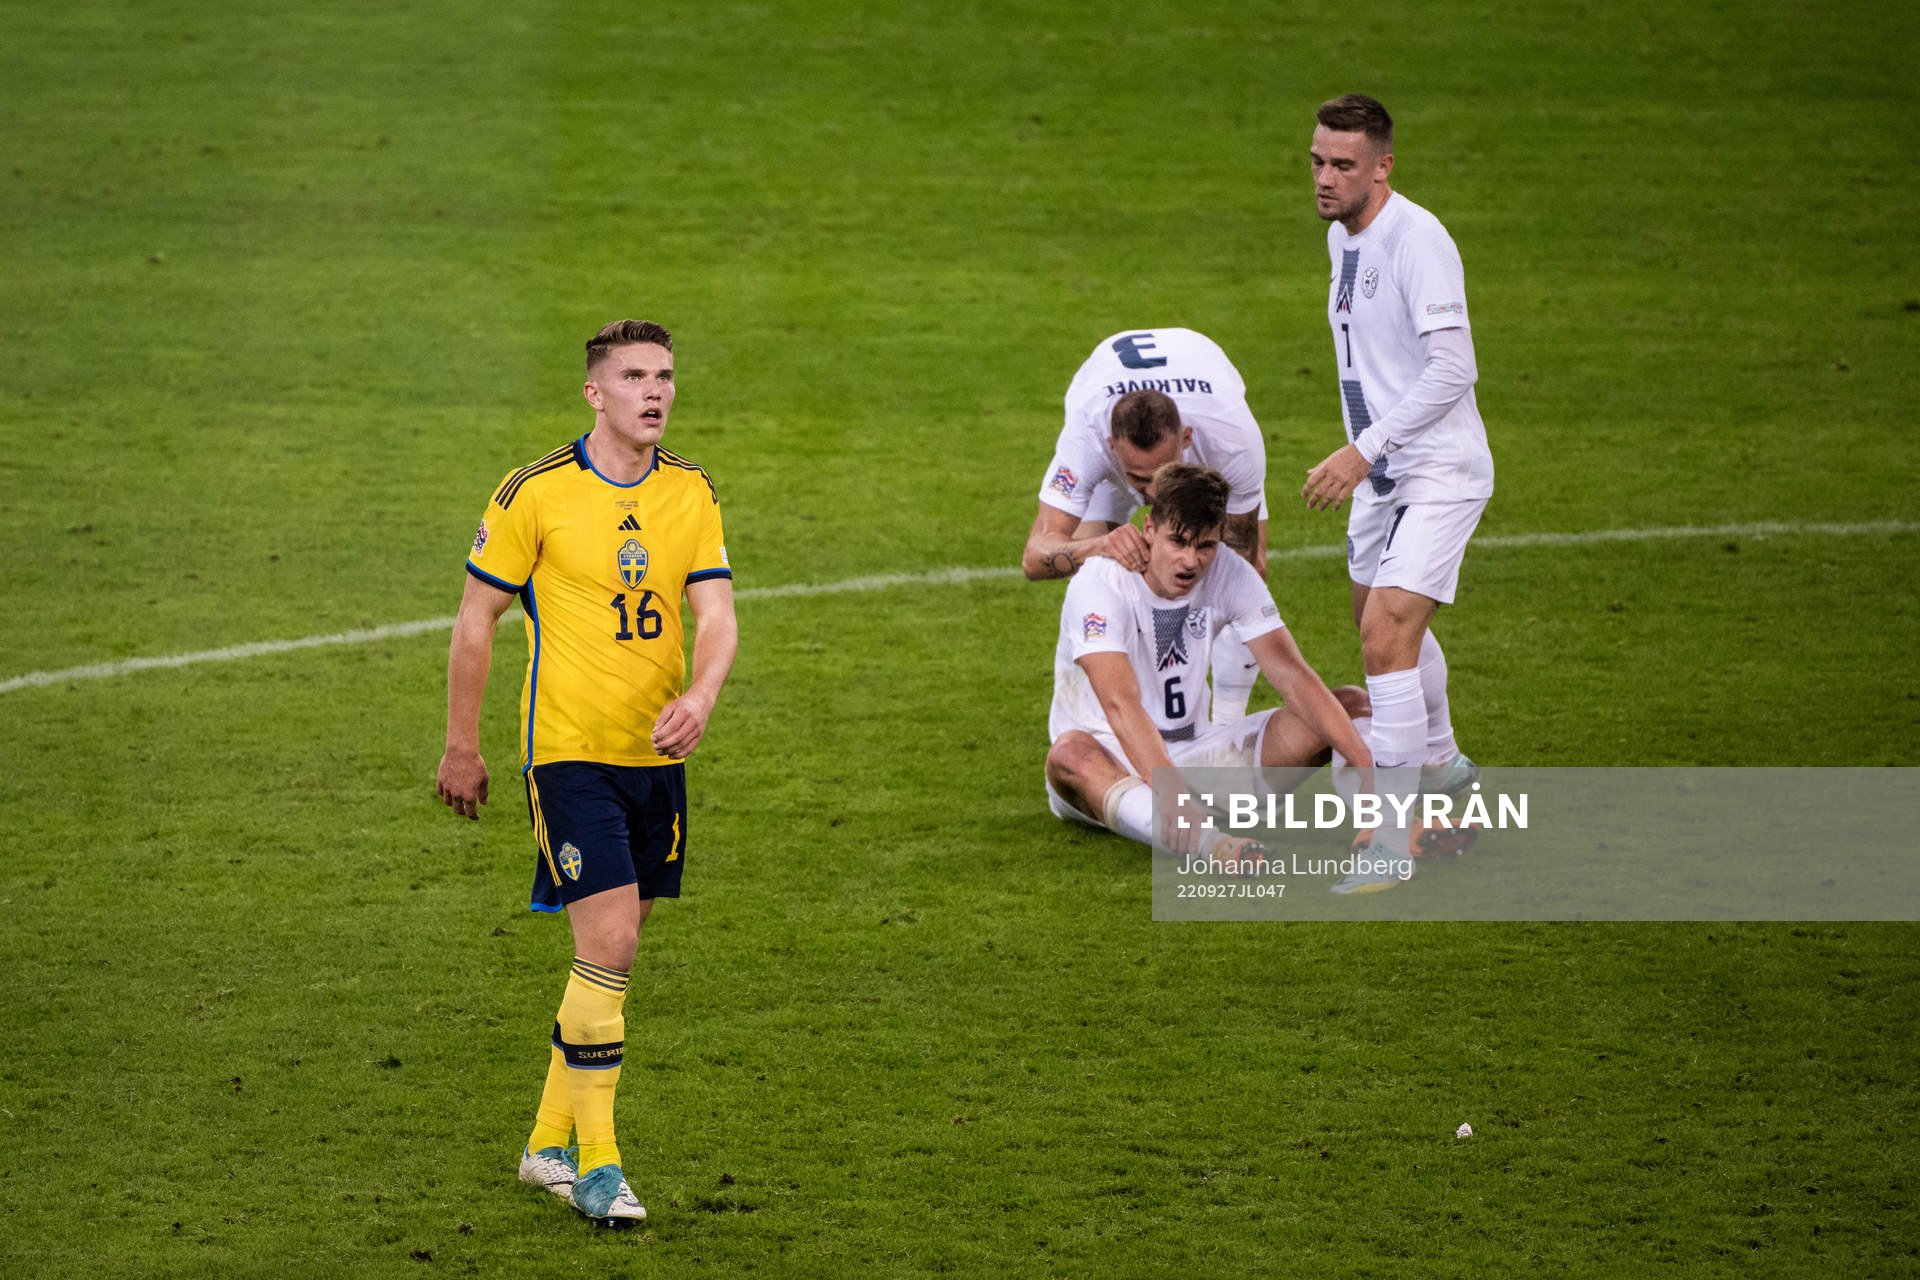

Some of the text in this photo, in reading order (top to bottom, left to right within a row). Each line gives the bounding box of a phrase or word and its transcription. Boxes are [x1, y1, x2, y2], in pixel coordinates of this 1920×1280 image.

[1112, 333, 1167, 370] 3
[610, 590, 662, 641] 16
[1164, 676, 1187, 720] 6
